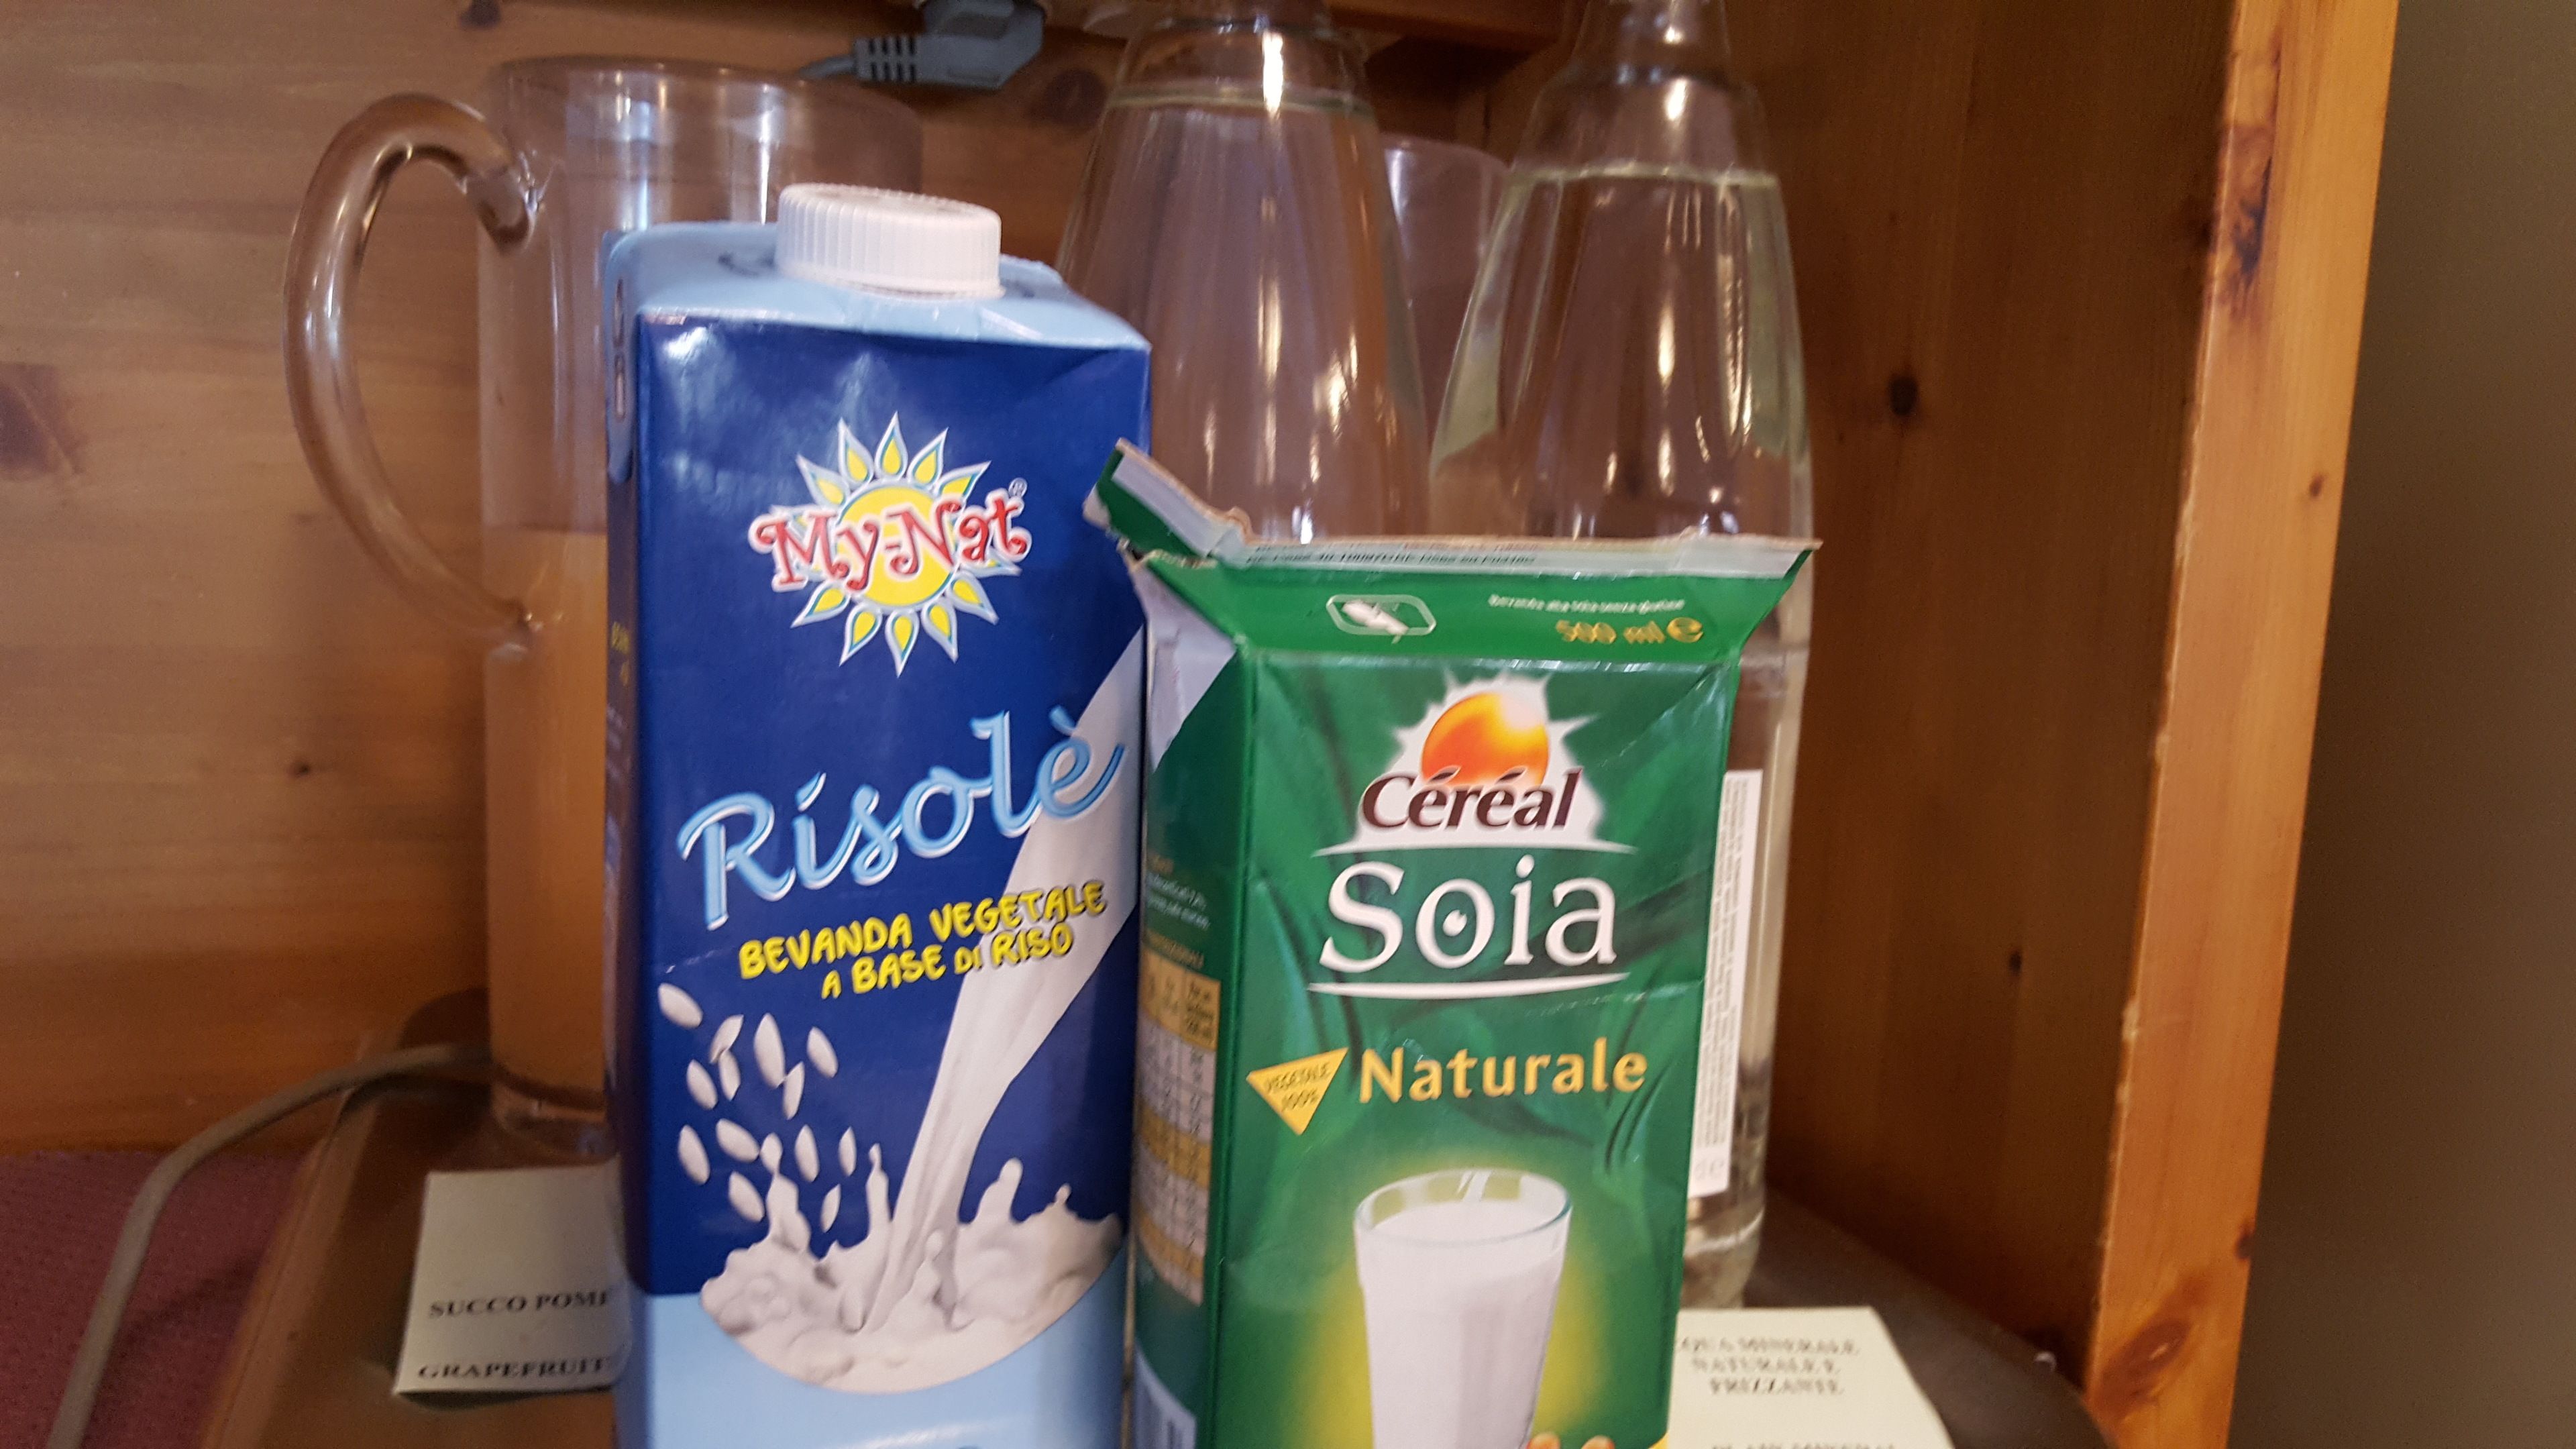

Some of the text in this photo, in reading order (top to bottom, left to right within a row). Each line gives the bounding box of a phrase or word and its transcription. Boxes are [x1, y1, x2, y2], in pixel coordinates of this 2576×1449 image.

[748, 490, 1032, 593] My-Nat
[1555, 619, 1617, 644] 500
[678, 706, 1125, 930] Risolè
[1360, 767, 1583, 830] Céréal
[739, 912, 914, 981] BEVANDA
[928, 880, 1108, 943] VEGETALE
[1319, 855, 1618, 974] Soia
[821, 922, 1075, 1000] A BASE DI RISO
[1359, 1036, 1648, 1104] Naturale
[429, 1296, 528, 1319] SUCCO
